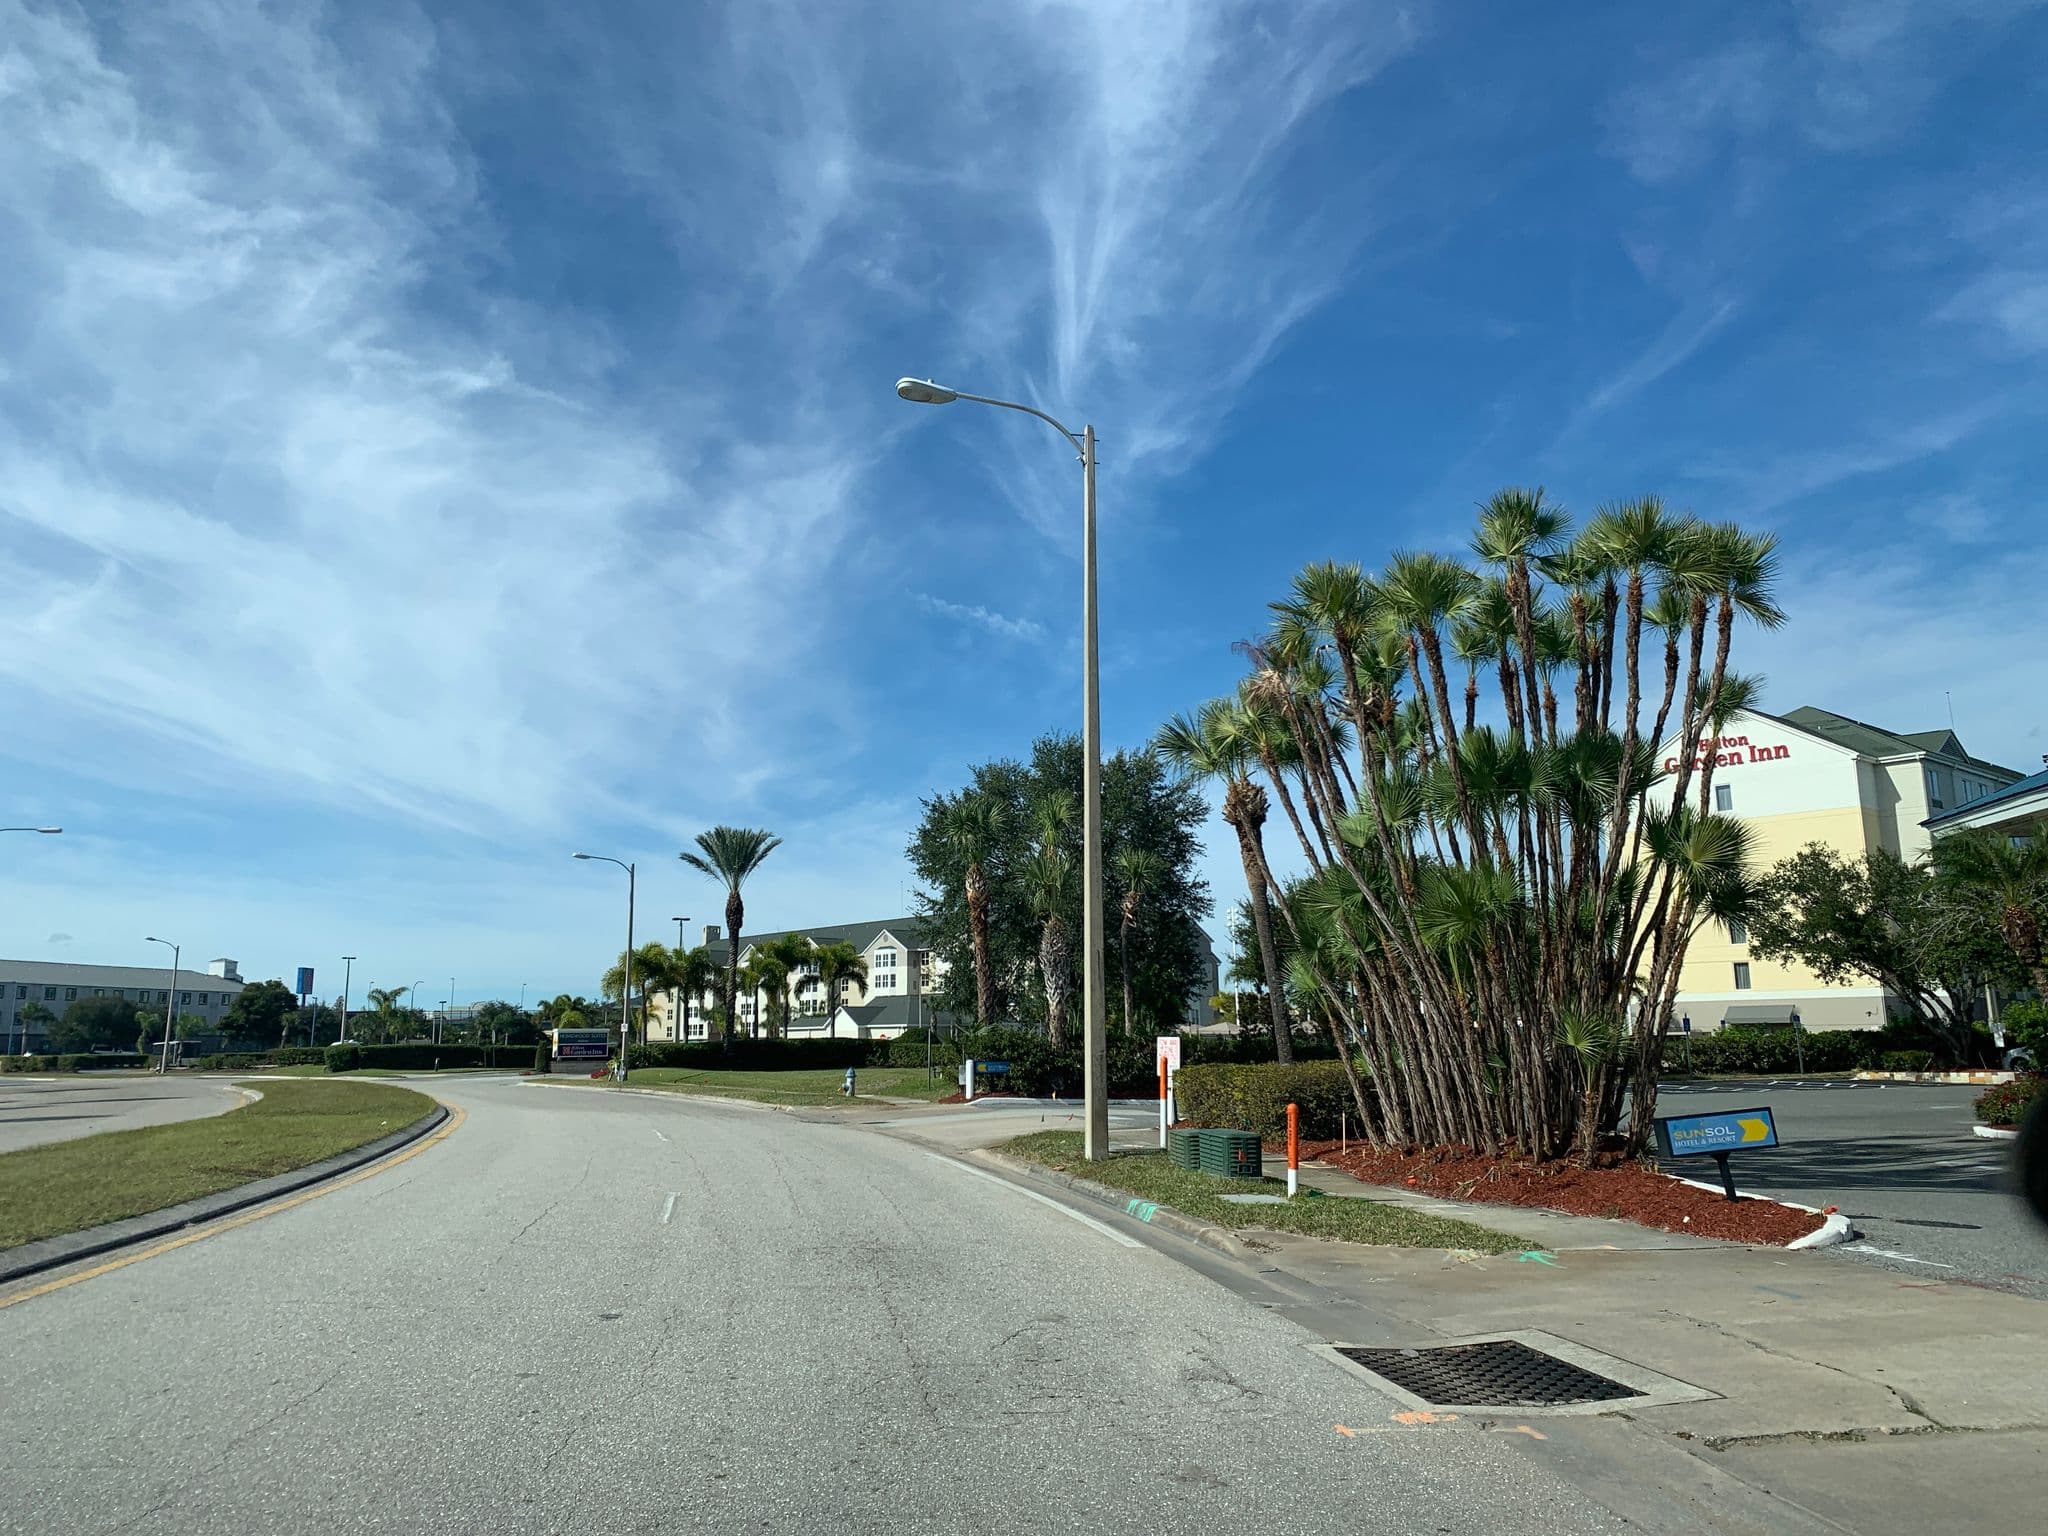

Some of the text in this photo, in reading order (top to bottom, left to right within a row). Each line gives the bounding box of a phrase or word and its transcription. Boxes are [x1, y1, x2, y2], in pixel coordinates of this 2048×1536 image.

[1699, 736, 1749, 752] Hlton
[1665, 745, 1790, 774] Gren Inn
[1674, 1127, 1735, 1140] SUNSOL
[1675, 1140, 1699, 1148] HOTEL
[1708, 1136, 1735, 1145] RESORT
